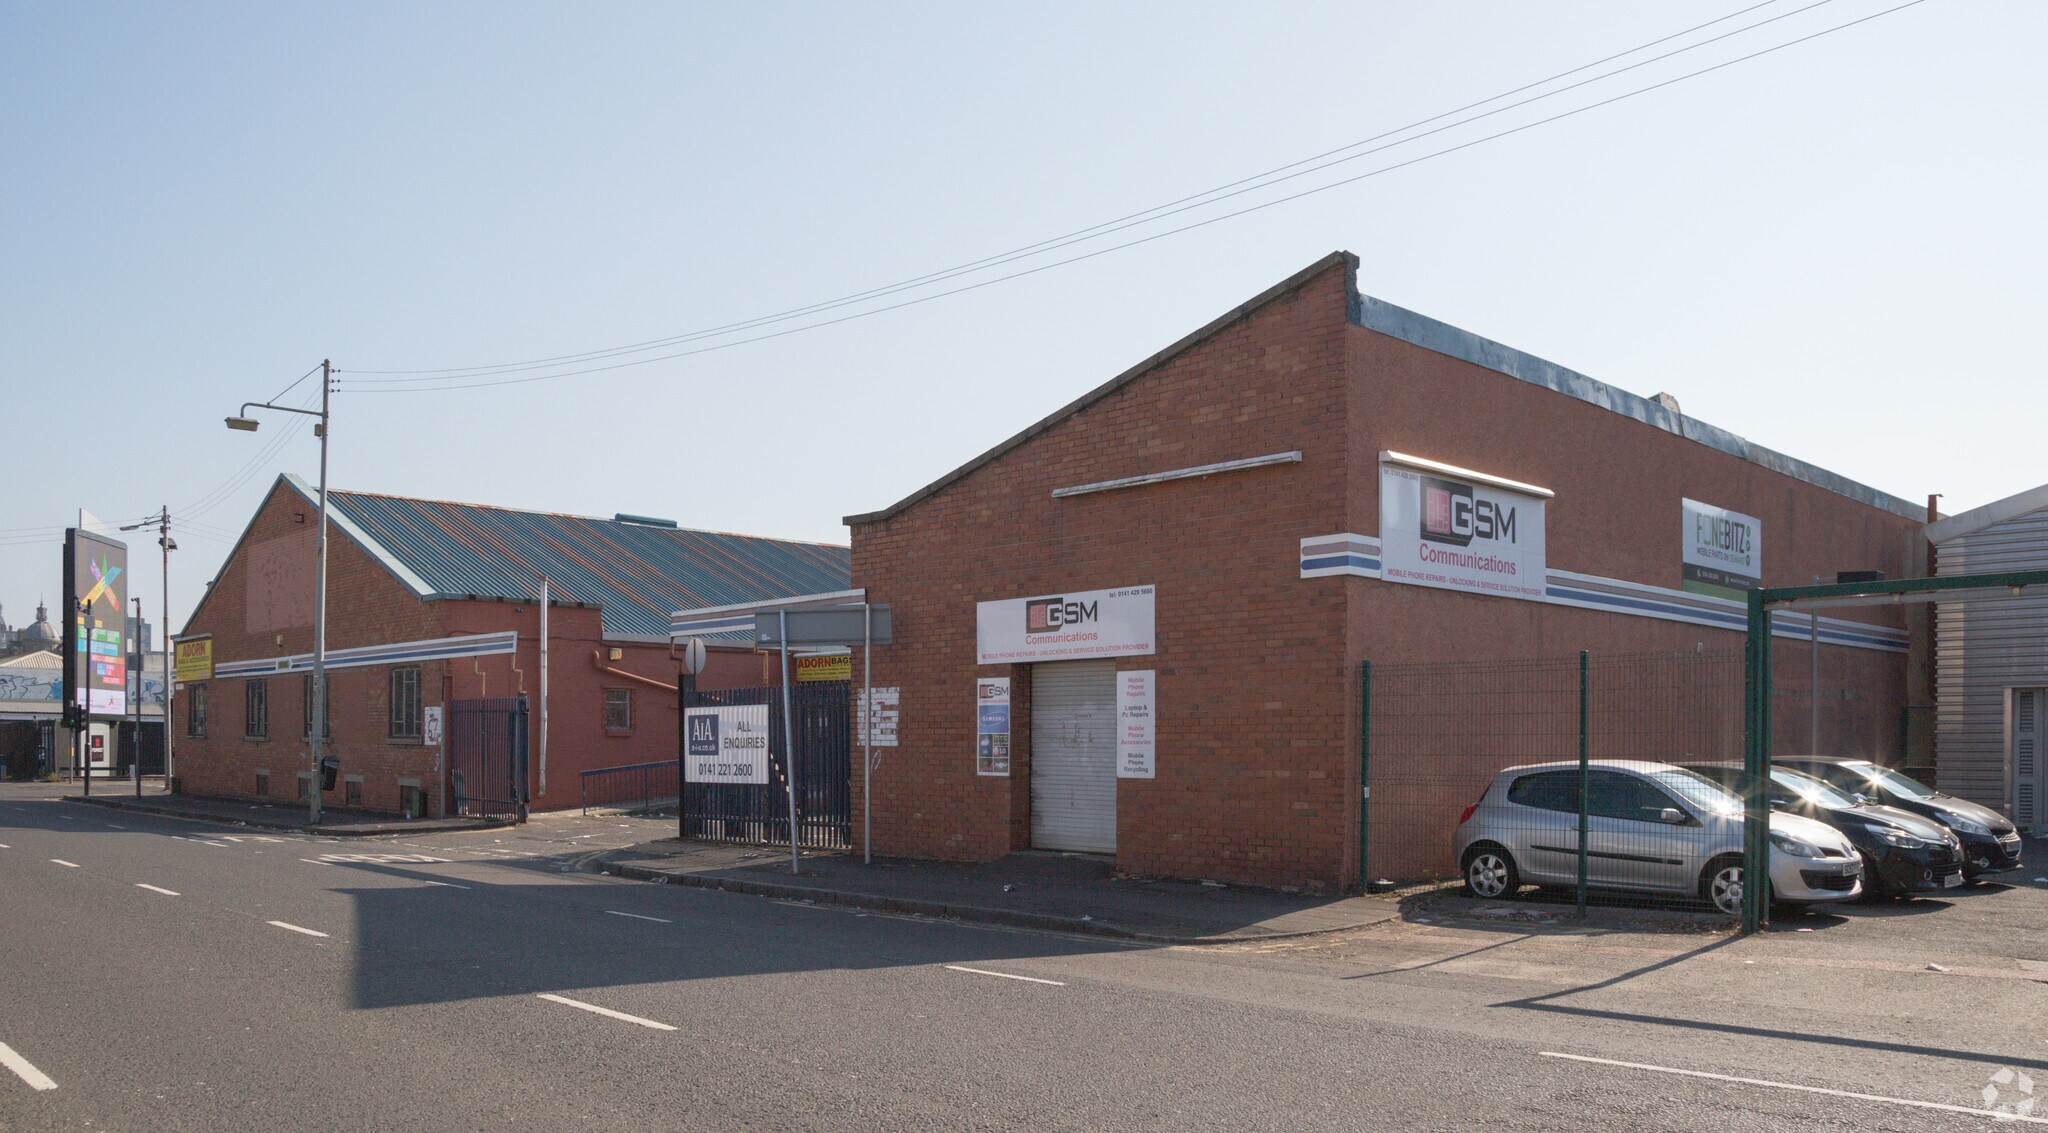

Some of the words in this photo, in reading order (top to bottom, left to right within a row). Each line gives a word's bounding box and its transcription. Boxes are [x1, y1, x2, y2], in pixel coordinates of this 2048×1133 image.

[1450, 494, 1516, 544] GSM
[1420, 543, 1516, 576] Communications
[1388, 568, 1407, 578] MOBILE
[1408, 571, 1425, 580] PHONE
[1426, 573, 1446, 583] REPAIRS
[1450, 577, 1476, 587] UNLOCKING
[1481, 582, 1499, 590] SERVICE
[1500, 584, 1520, 593] SOLUTION
[1521, 587, 1541, 596] PROVIDER
[1046, 600, 1098, 627] GSM
[1026, 631, 1098, 645] Communications
[182, 642, 206, 657] ADORN
[798, 657, 831, 668] ADORN
[988, 686, 1008, 696] GSM
[737, 720, 751, 732] ALL
[724, 736, 765, 749] ENQUIRIES
[699, 764, 716, 776] 0141
[718, 764, 731, 776] 221
[733, 764, 752, 776] 2600
